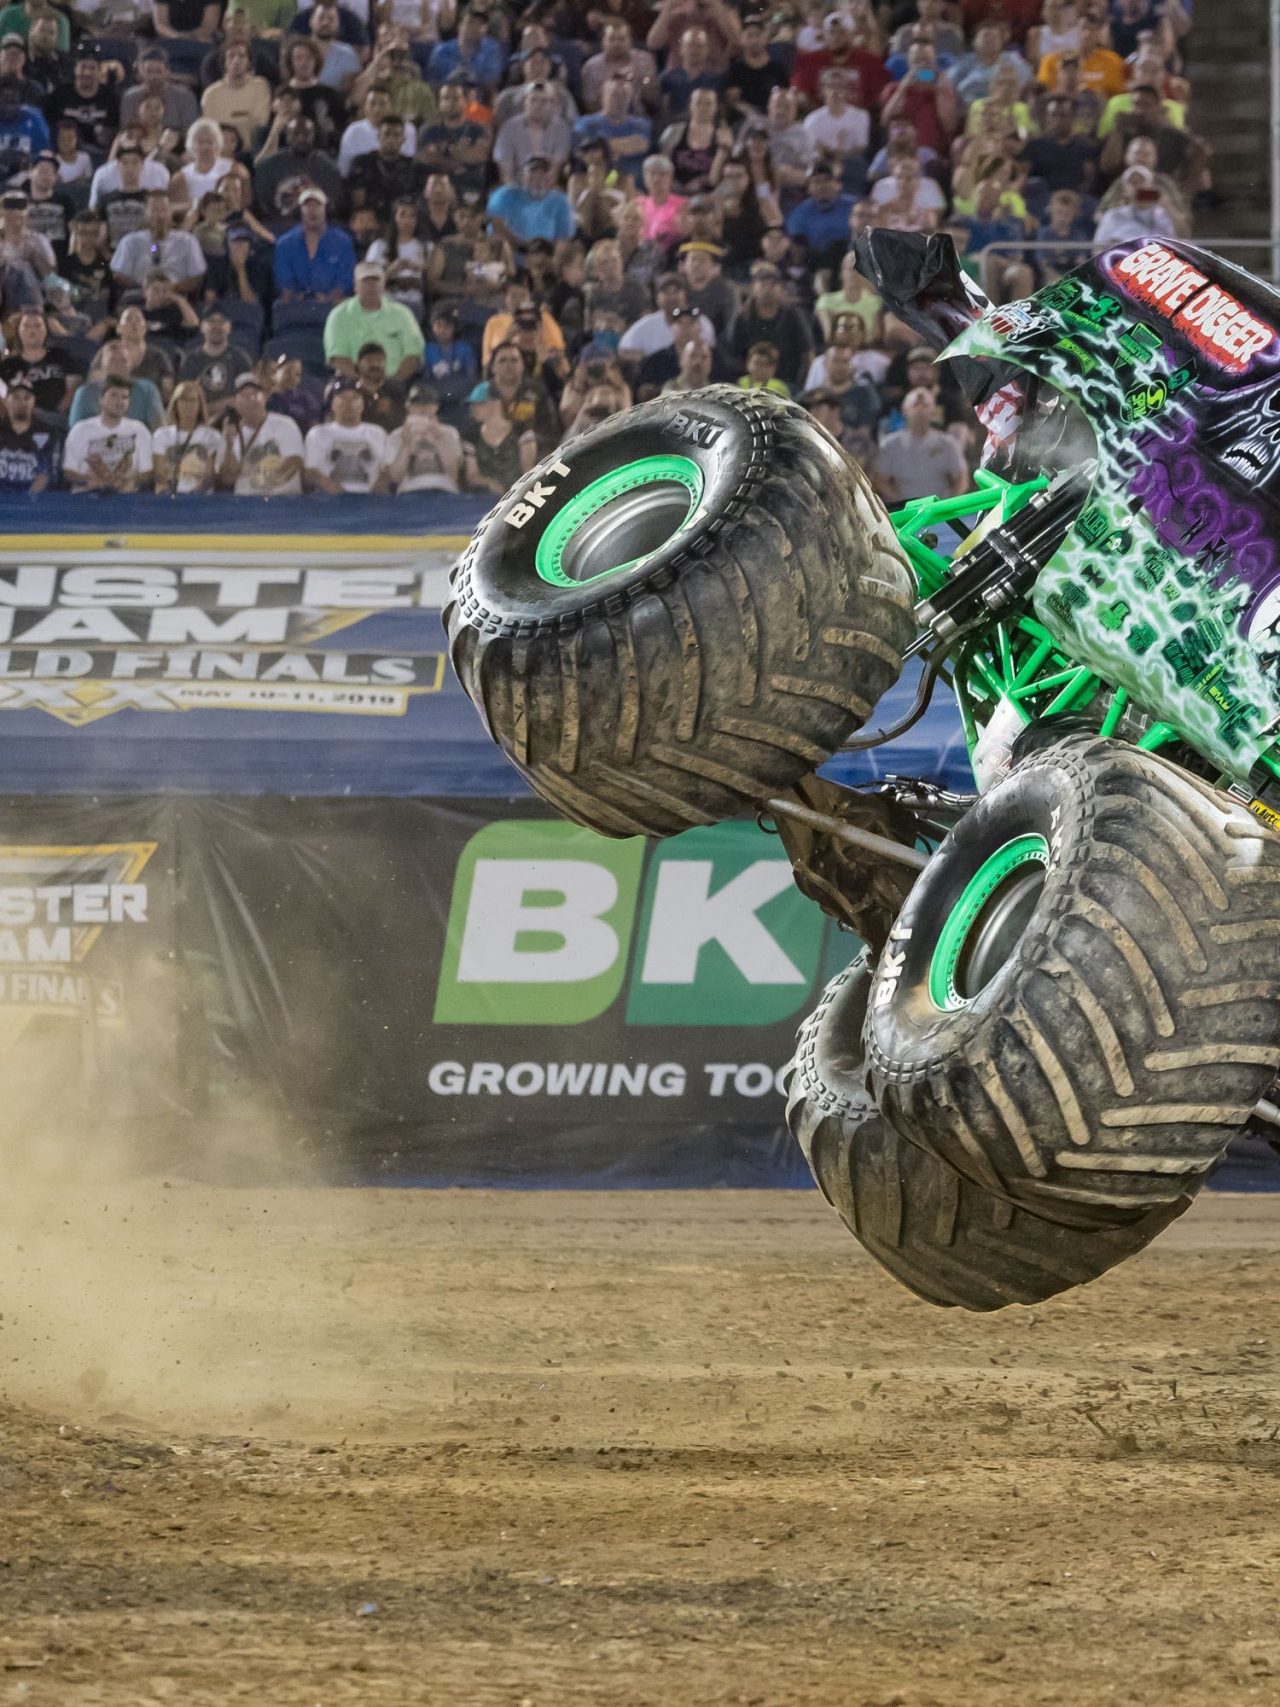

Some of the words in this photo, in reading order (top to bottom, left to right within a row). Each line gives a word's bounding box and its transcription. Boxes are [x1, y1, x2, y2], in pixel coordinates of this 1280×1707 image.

[1118, 243, 1206, 307] GRAVE
[1180, 284, 1275, 363] DIGGER
[668, 410, 727, 451] BKT
[503, 459, 572, 529] BKT
[1079, 508, 1110, 538] ALIEN
[111, 651, 416, 684] FINALS
[874, 924, 912, 1008] BKT
[428, 1061, 687, 1097] GROWING
